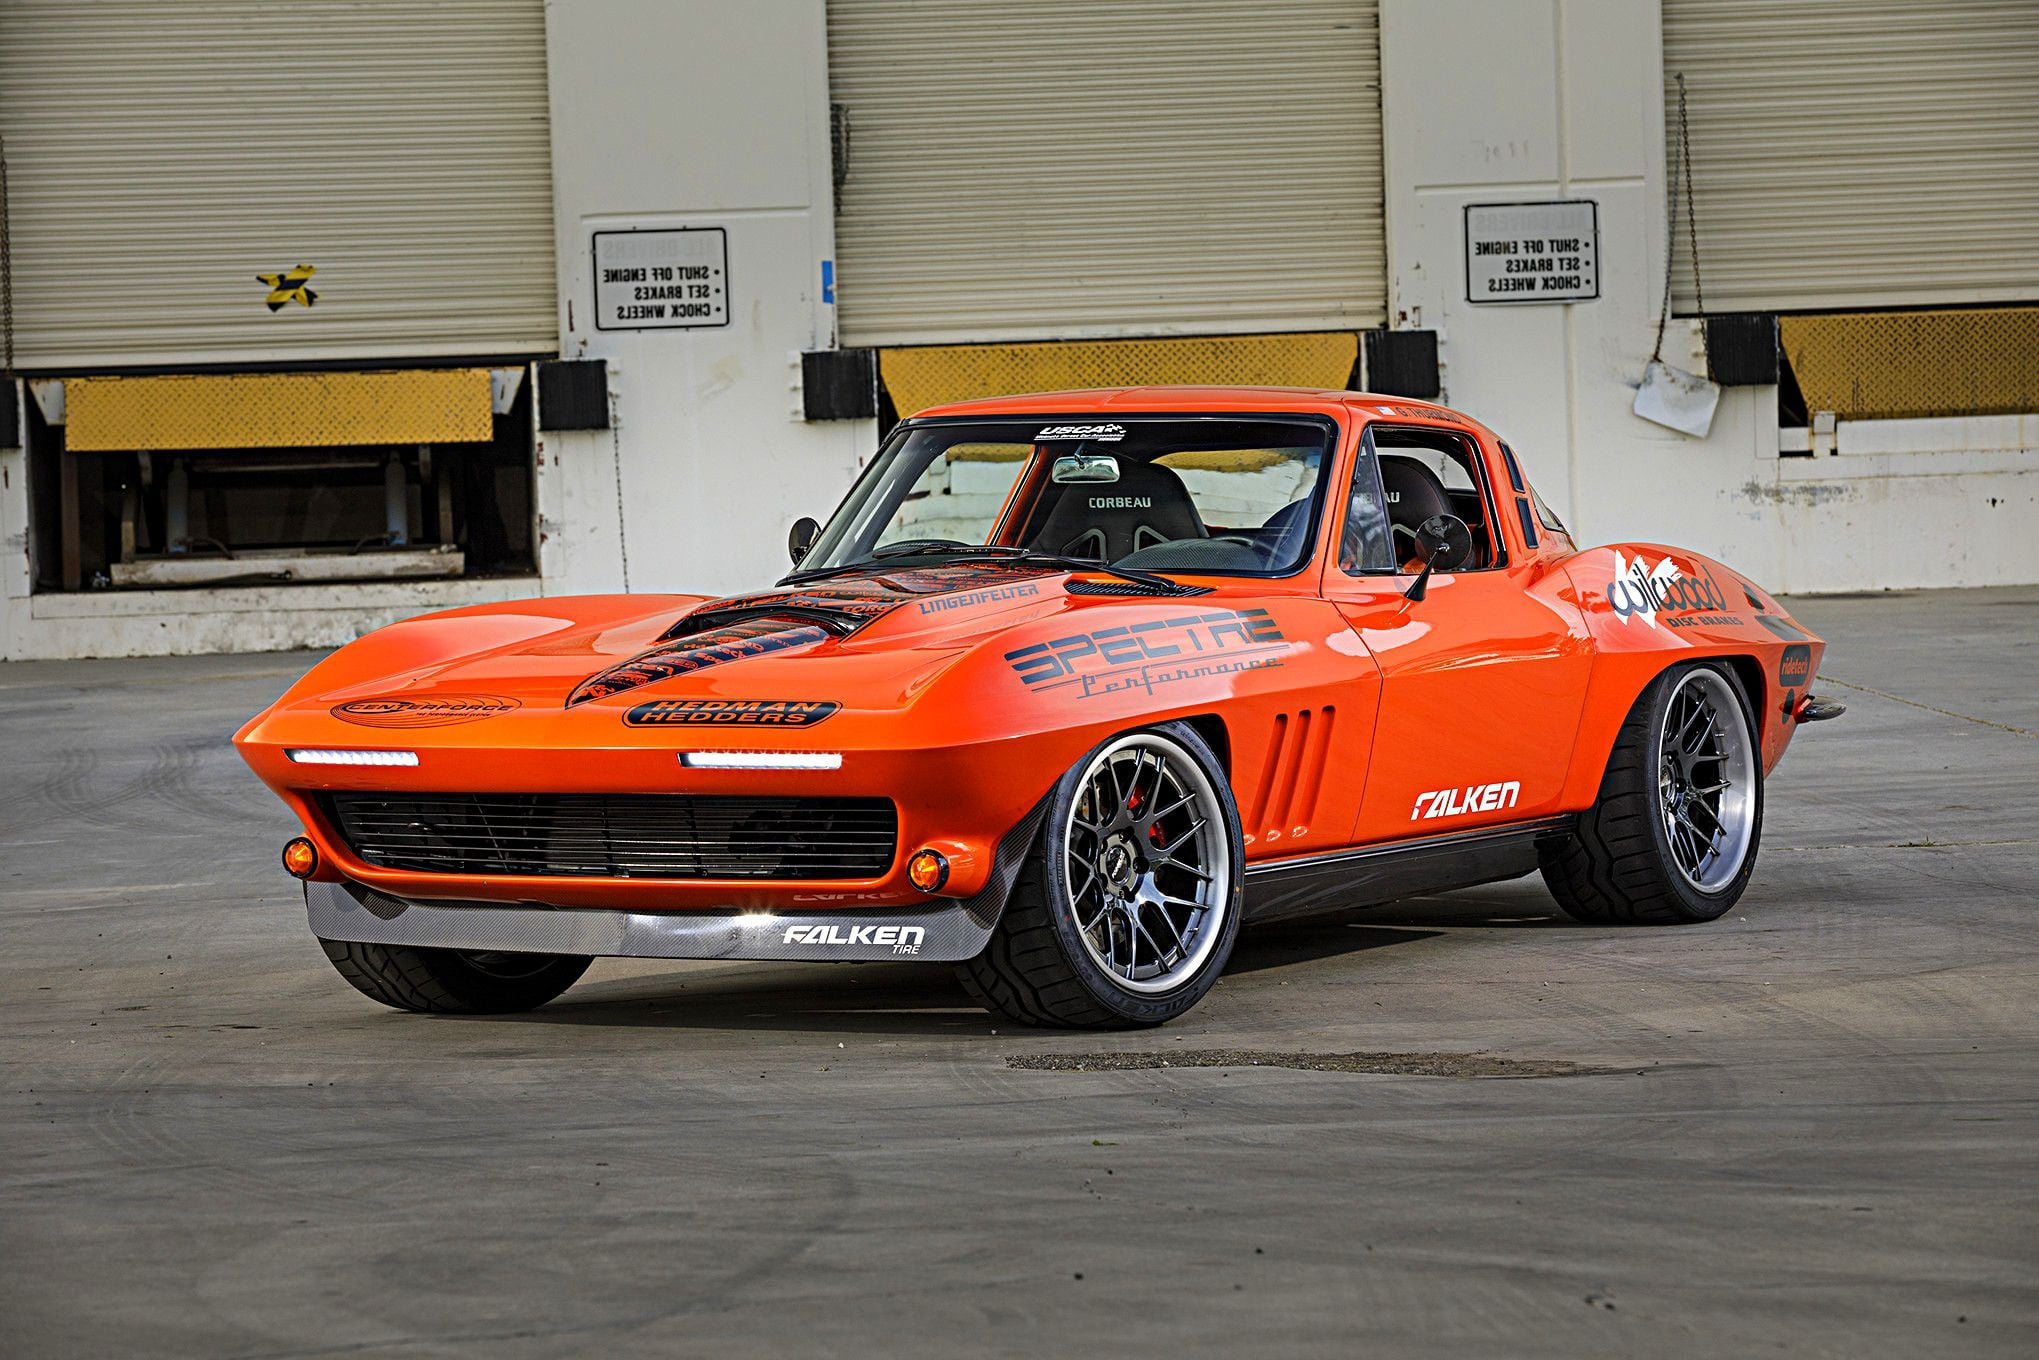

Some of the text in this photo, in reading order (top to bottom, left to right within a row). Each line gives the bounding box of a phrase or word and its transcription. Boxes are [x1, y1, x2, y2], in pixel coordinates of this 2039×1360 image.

[1039, 425, 1106, 435] USCA
[1088, 496, 1152, 509] CORBEAU
[918, 583, 1040, 615] LINGENFELTER
[1665, 616, 1744, 628] DISC BRAKES
[1003, 607, 1285, 685] SPECTRE
[1076, 656, 1285, 699] Performance
[350, 703, 515, 712] CENTERFORCE
[651, 701, 822, 713] HEDMAN
[640, 712, 807, 723] HEDDERS
[1410, 781, 1520, 820] FALKEN
[782, 925, 925, 945] FALKEN
[892, 944, 921, 955] TIRE
